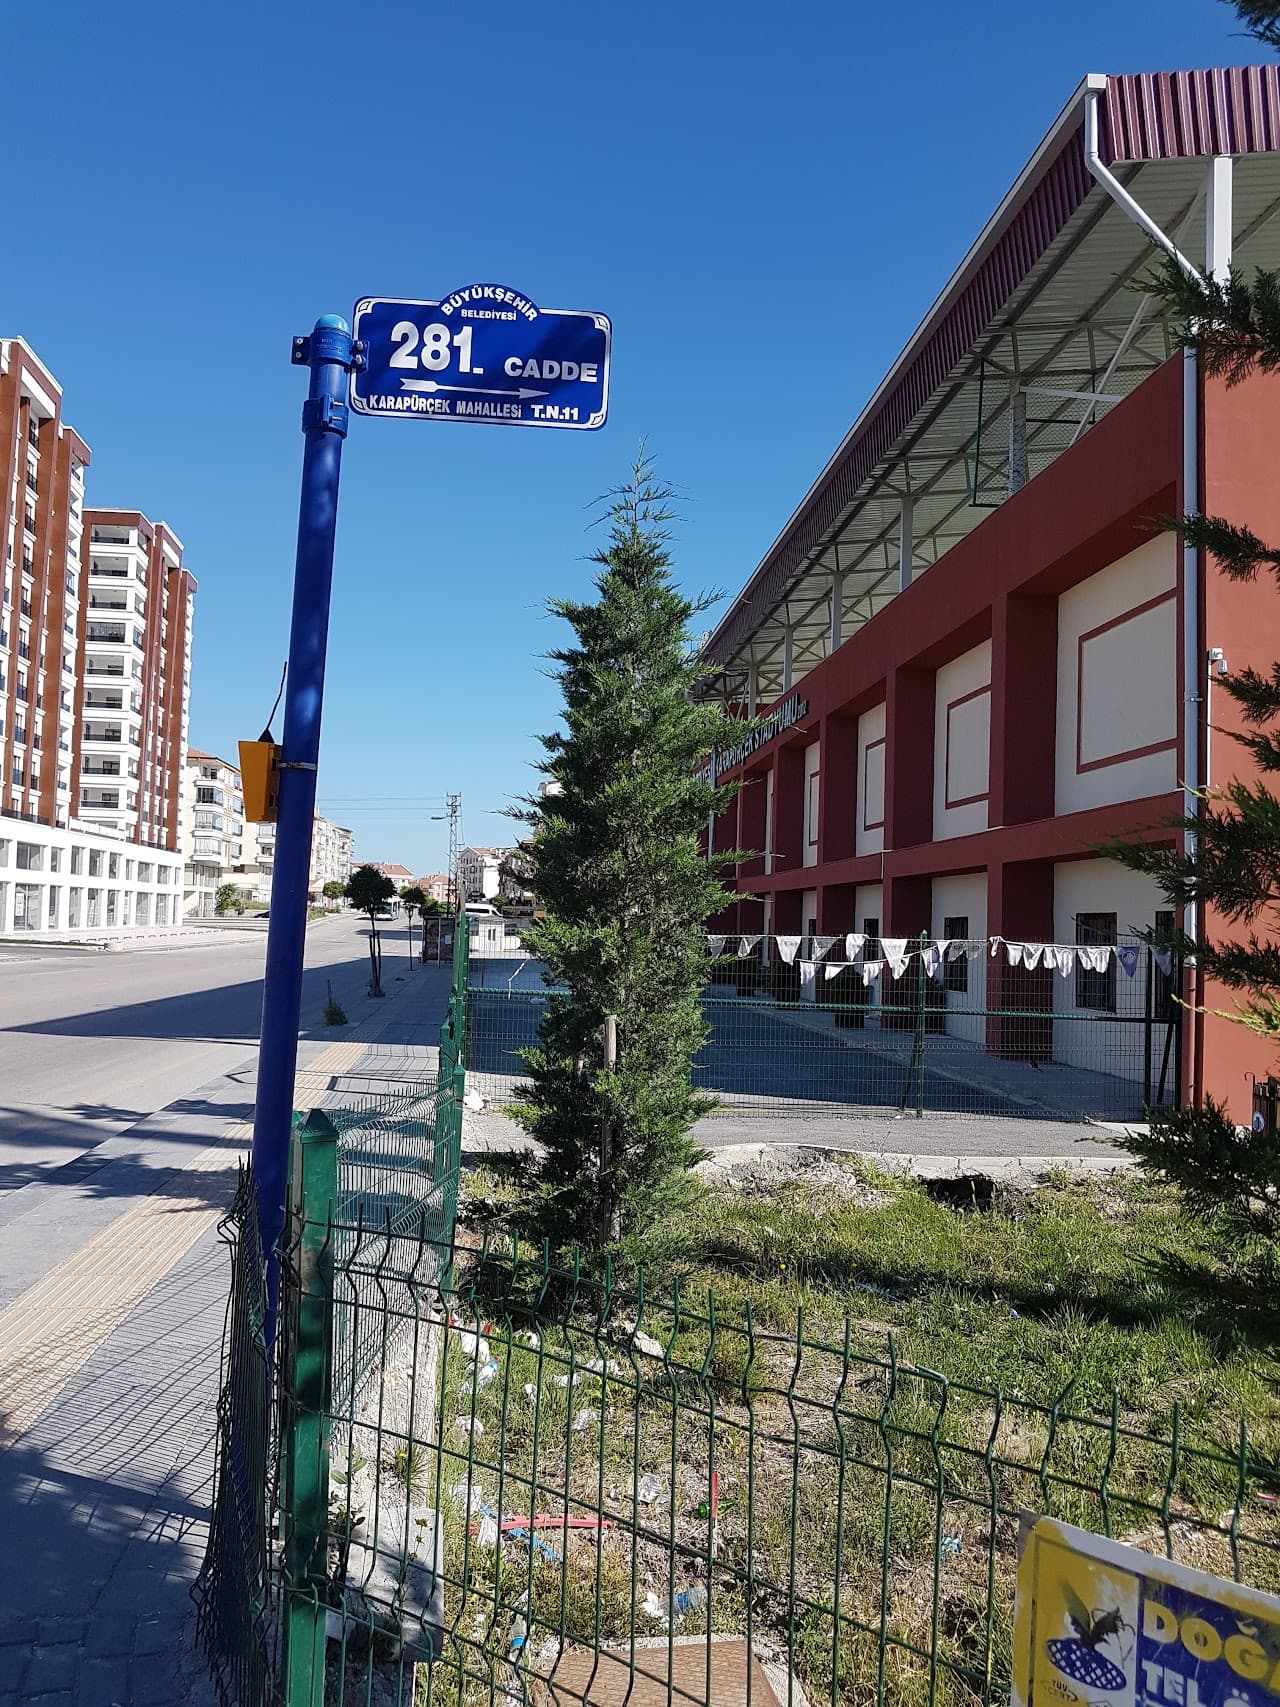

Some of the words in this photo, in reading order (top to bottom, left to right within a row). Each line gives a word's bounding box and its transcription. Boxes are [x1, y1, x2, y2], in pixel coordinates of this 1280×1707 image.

[440, 286, 538, 322] BÜYÜKŞEHİR
[461, 309, 517, 321] BELEDİYESİ
[389, 321, 484, 375] 281.
[504, 357, 598, 383] CADDE
[369, 394, 450, 415] KARAPÜRÇEK
[531, 404, 579, 421] T.N.11
